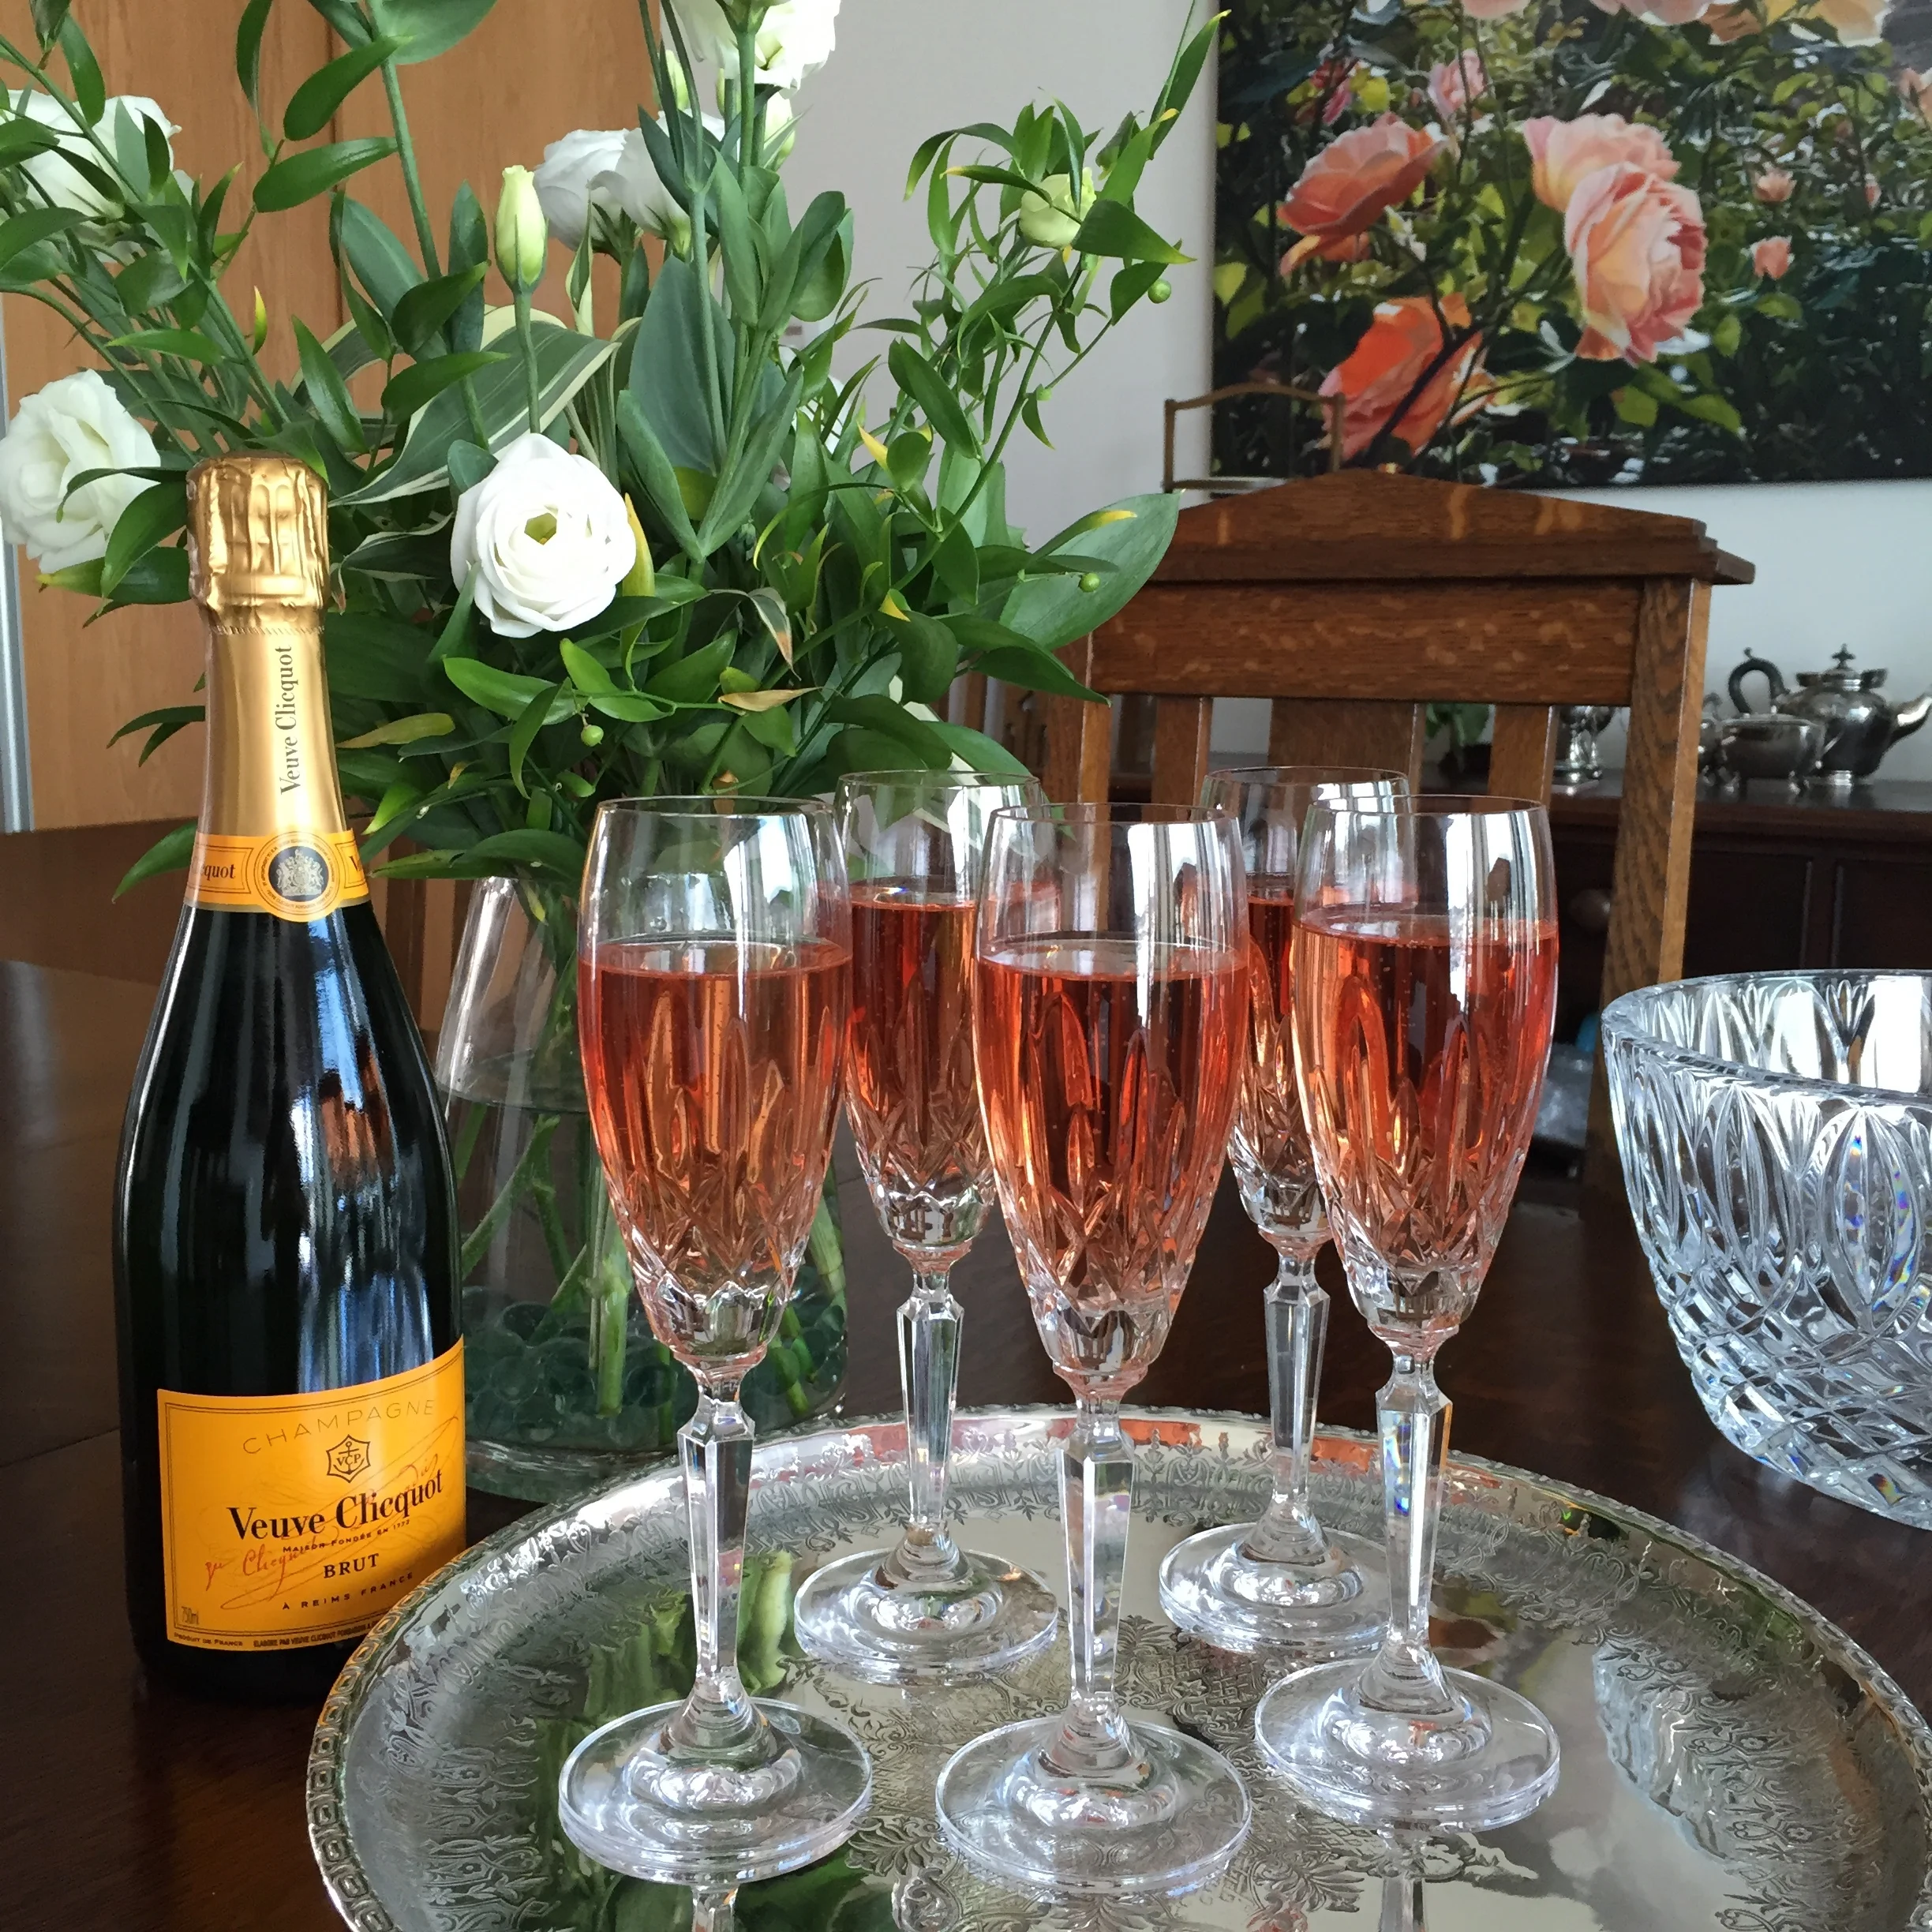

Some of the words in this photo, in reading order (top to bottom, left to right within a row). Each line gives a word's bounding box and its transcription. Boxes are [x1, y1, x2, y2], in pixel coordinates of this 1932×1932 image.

[275, 644, 299, 731] Clicquot
[280, 736, 301, 796] Veuve
[243, 1399, 435, 1455] CHAMPAGNE
[226, 1507, 325, 1540] Veuve
[335, 1470, 444, 1529] Clicquot
[301, 1593, 350, 1608] REIMS
[361, 1572, 413, 1596] FRANCE
[324, 1553, 380, 1579] BRUT
